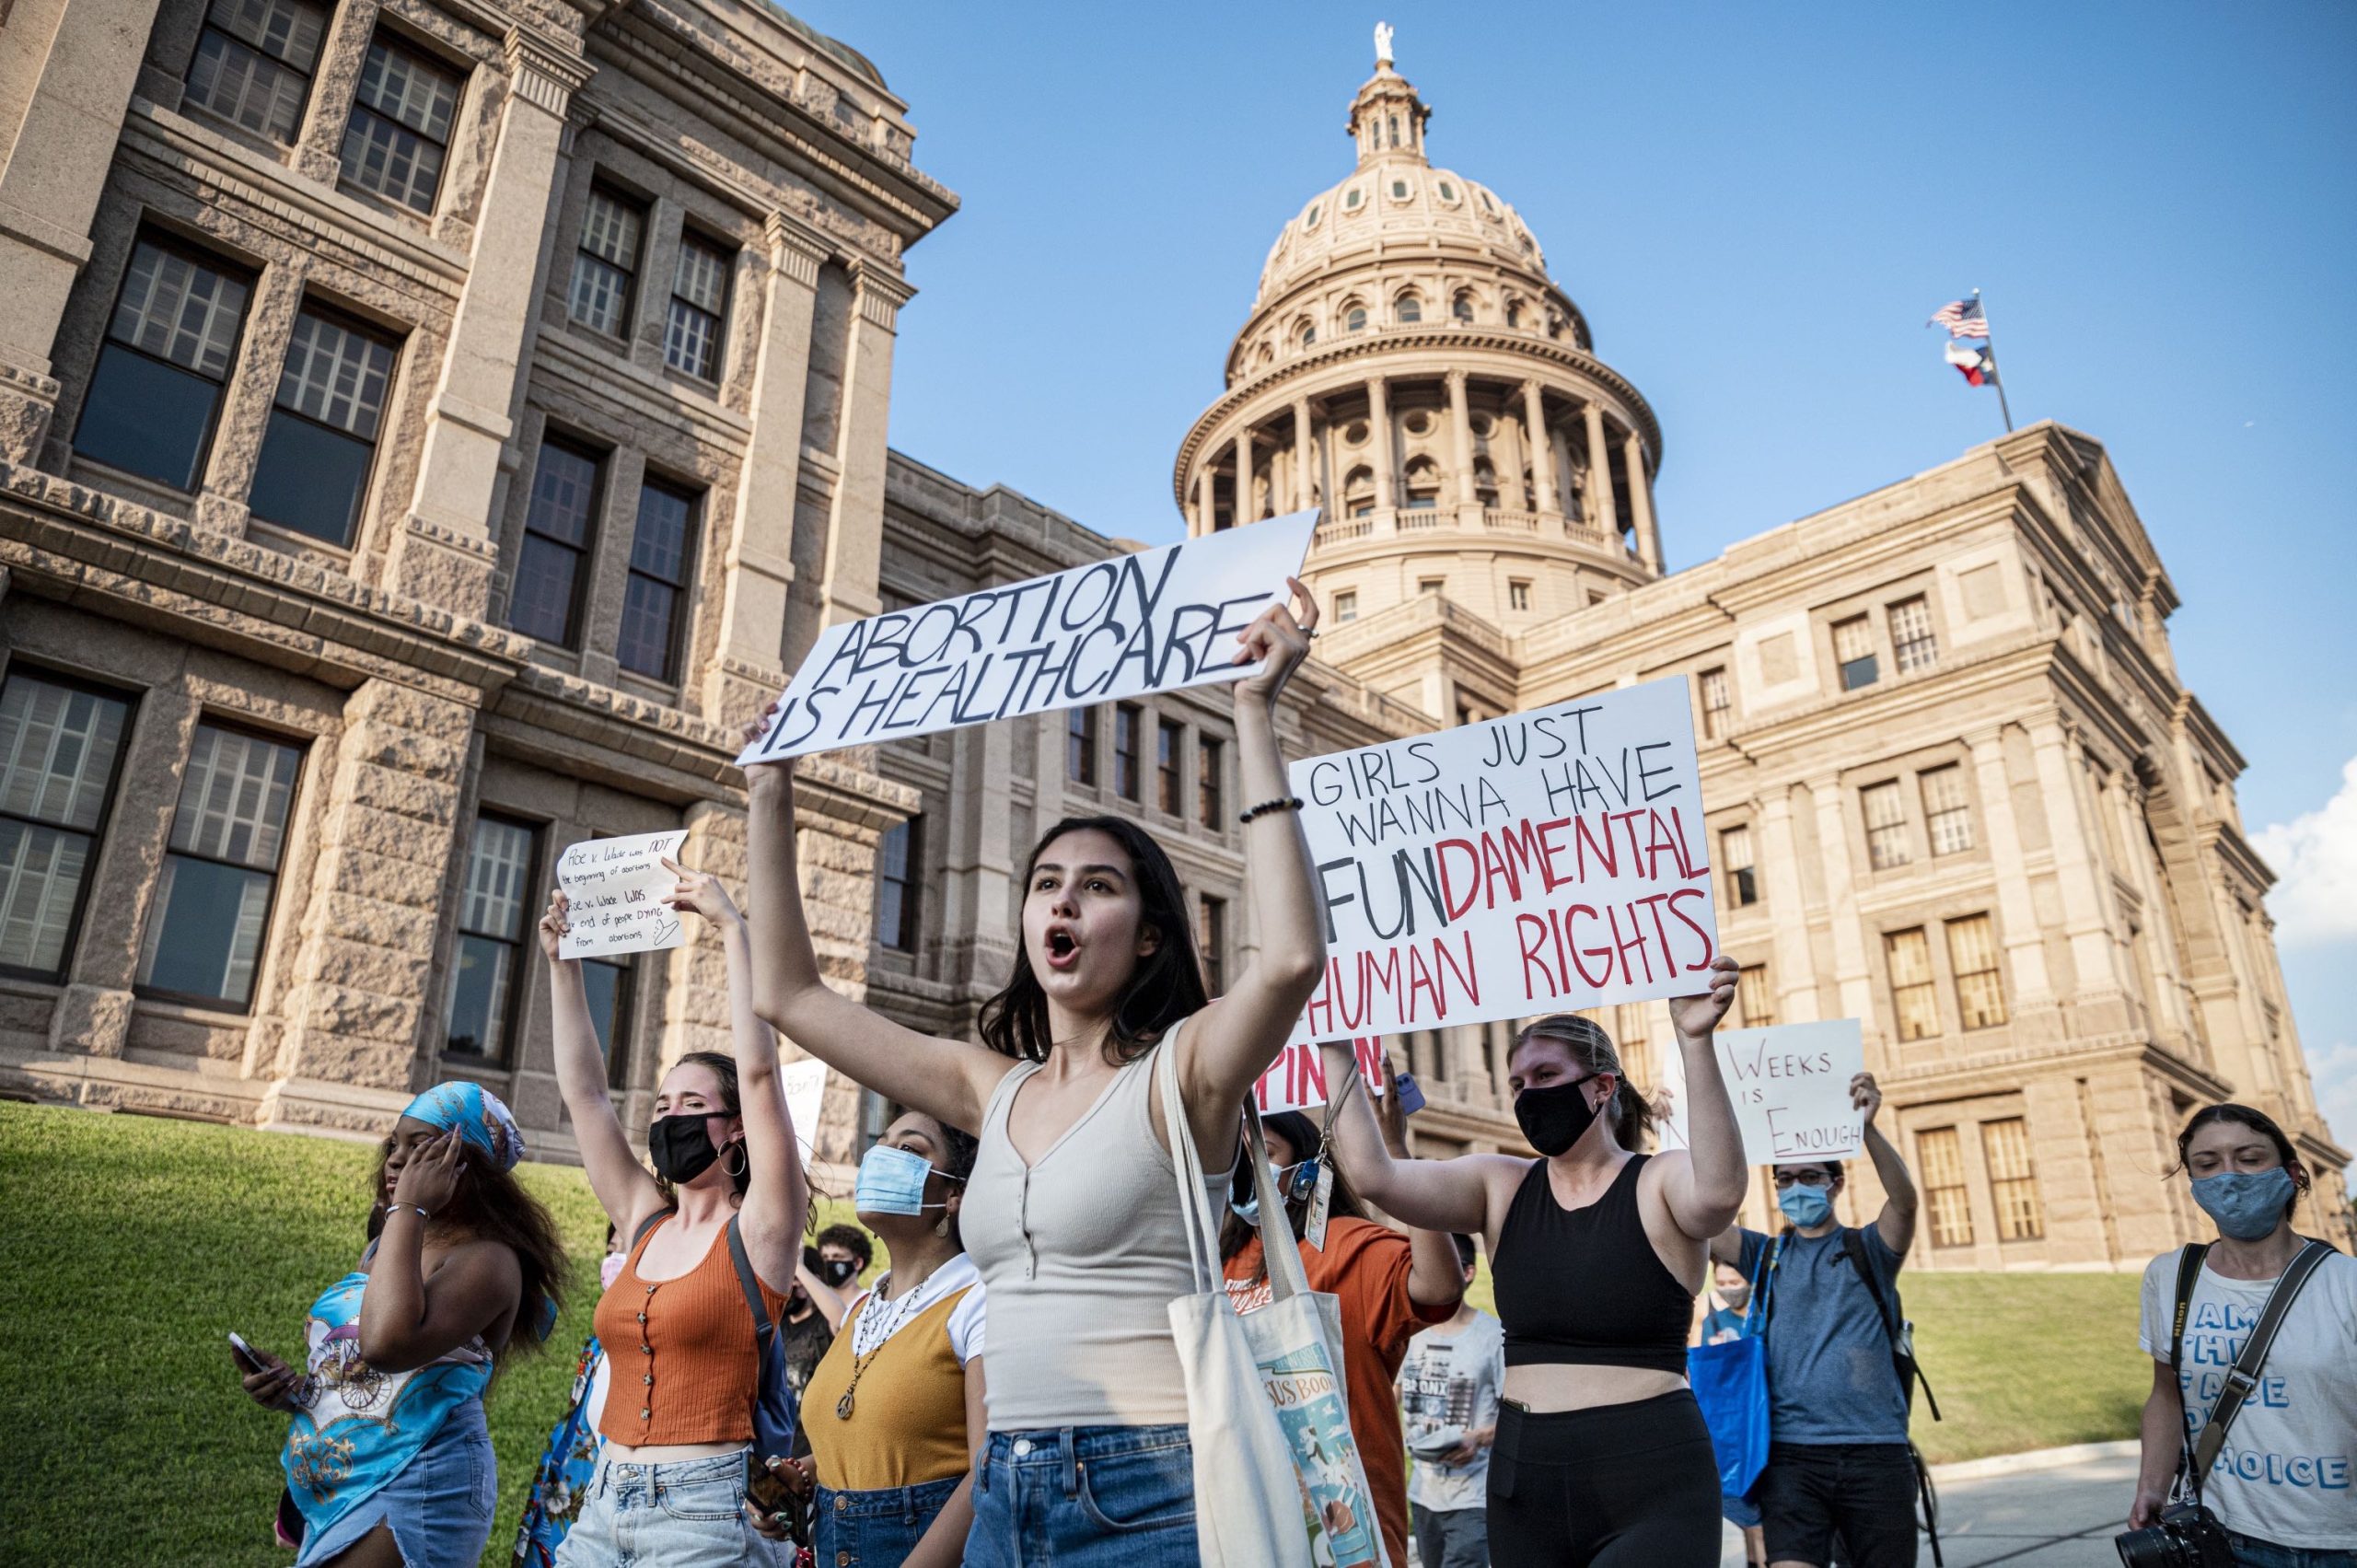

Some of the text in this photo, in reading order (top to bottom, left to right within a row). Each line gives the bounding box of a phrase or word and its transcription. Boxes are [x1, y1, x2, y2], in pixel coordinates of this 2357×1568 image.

[812, 545, 1181, 690] ABORTION
[761, 592, 1274, 754] IS HEALTHCARE
[1310, 706, 1603, 807] GIRLS JUST
[1336, 742, 1682, 846] WANNA HAVE
[568, 848, 586, 866] Roe
[604, 846, 625, 862] Wade
[574, 870, 606, 886] beginning
[610, 866, 618, 876] of
[621, 863, 651, 874] abortions
[1317, 807, 1710, 944] FUNDAMENTAL
[597, 895, 618, 907] Wade
[624, 889, 646, 904] WAS
[580, 915, 596, 928] end
[602, 912, 610, 926] of
[614, 912, 633, 928] people
[575, 931, 643, 947] from abortions
[1307, 889, 1713, 1037] HUMAN RIGHTS
[1742, 1088, 1763, 1105] IS
[2174, 1302, 2187, 1337] Nikon
[2195, 1303, 2261, 1330] AM
[1403, 1378, 1447, 1397] BRONX
